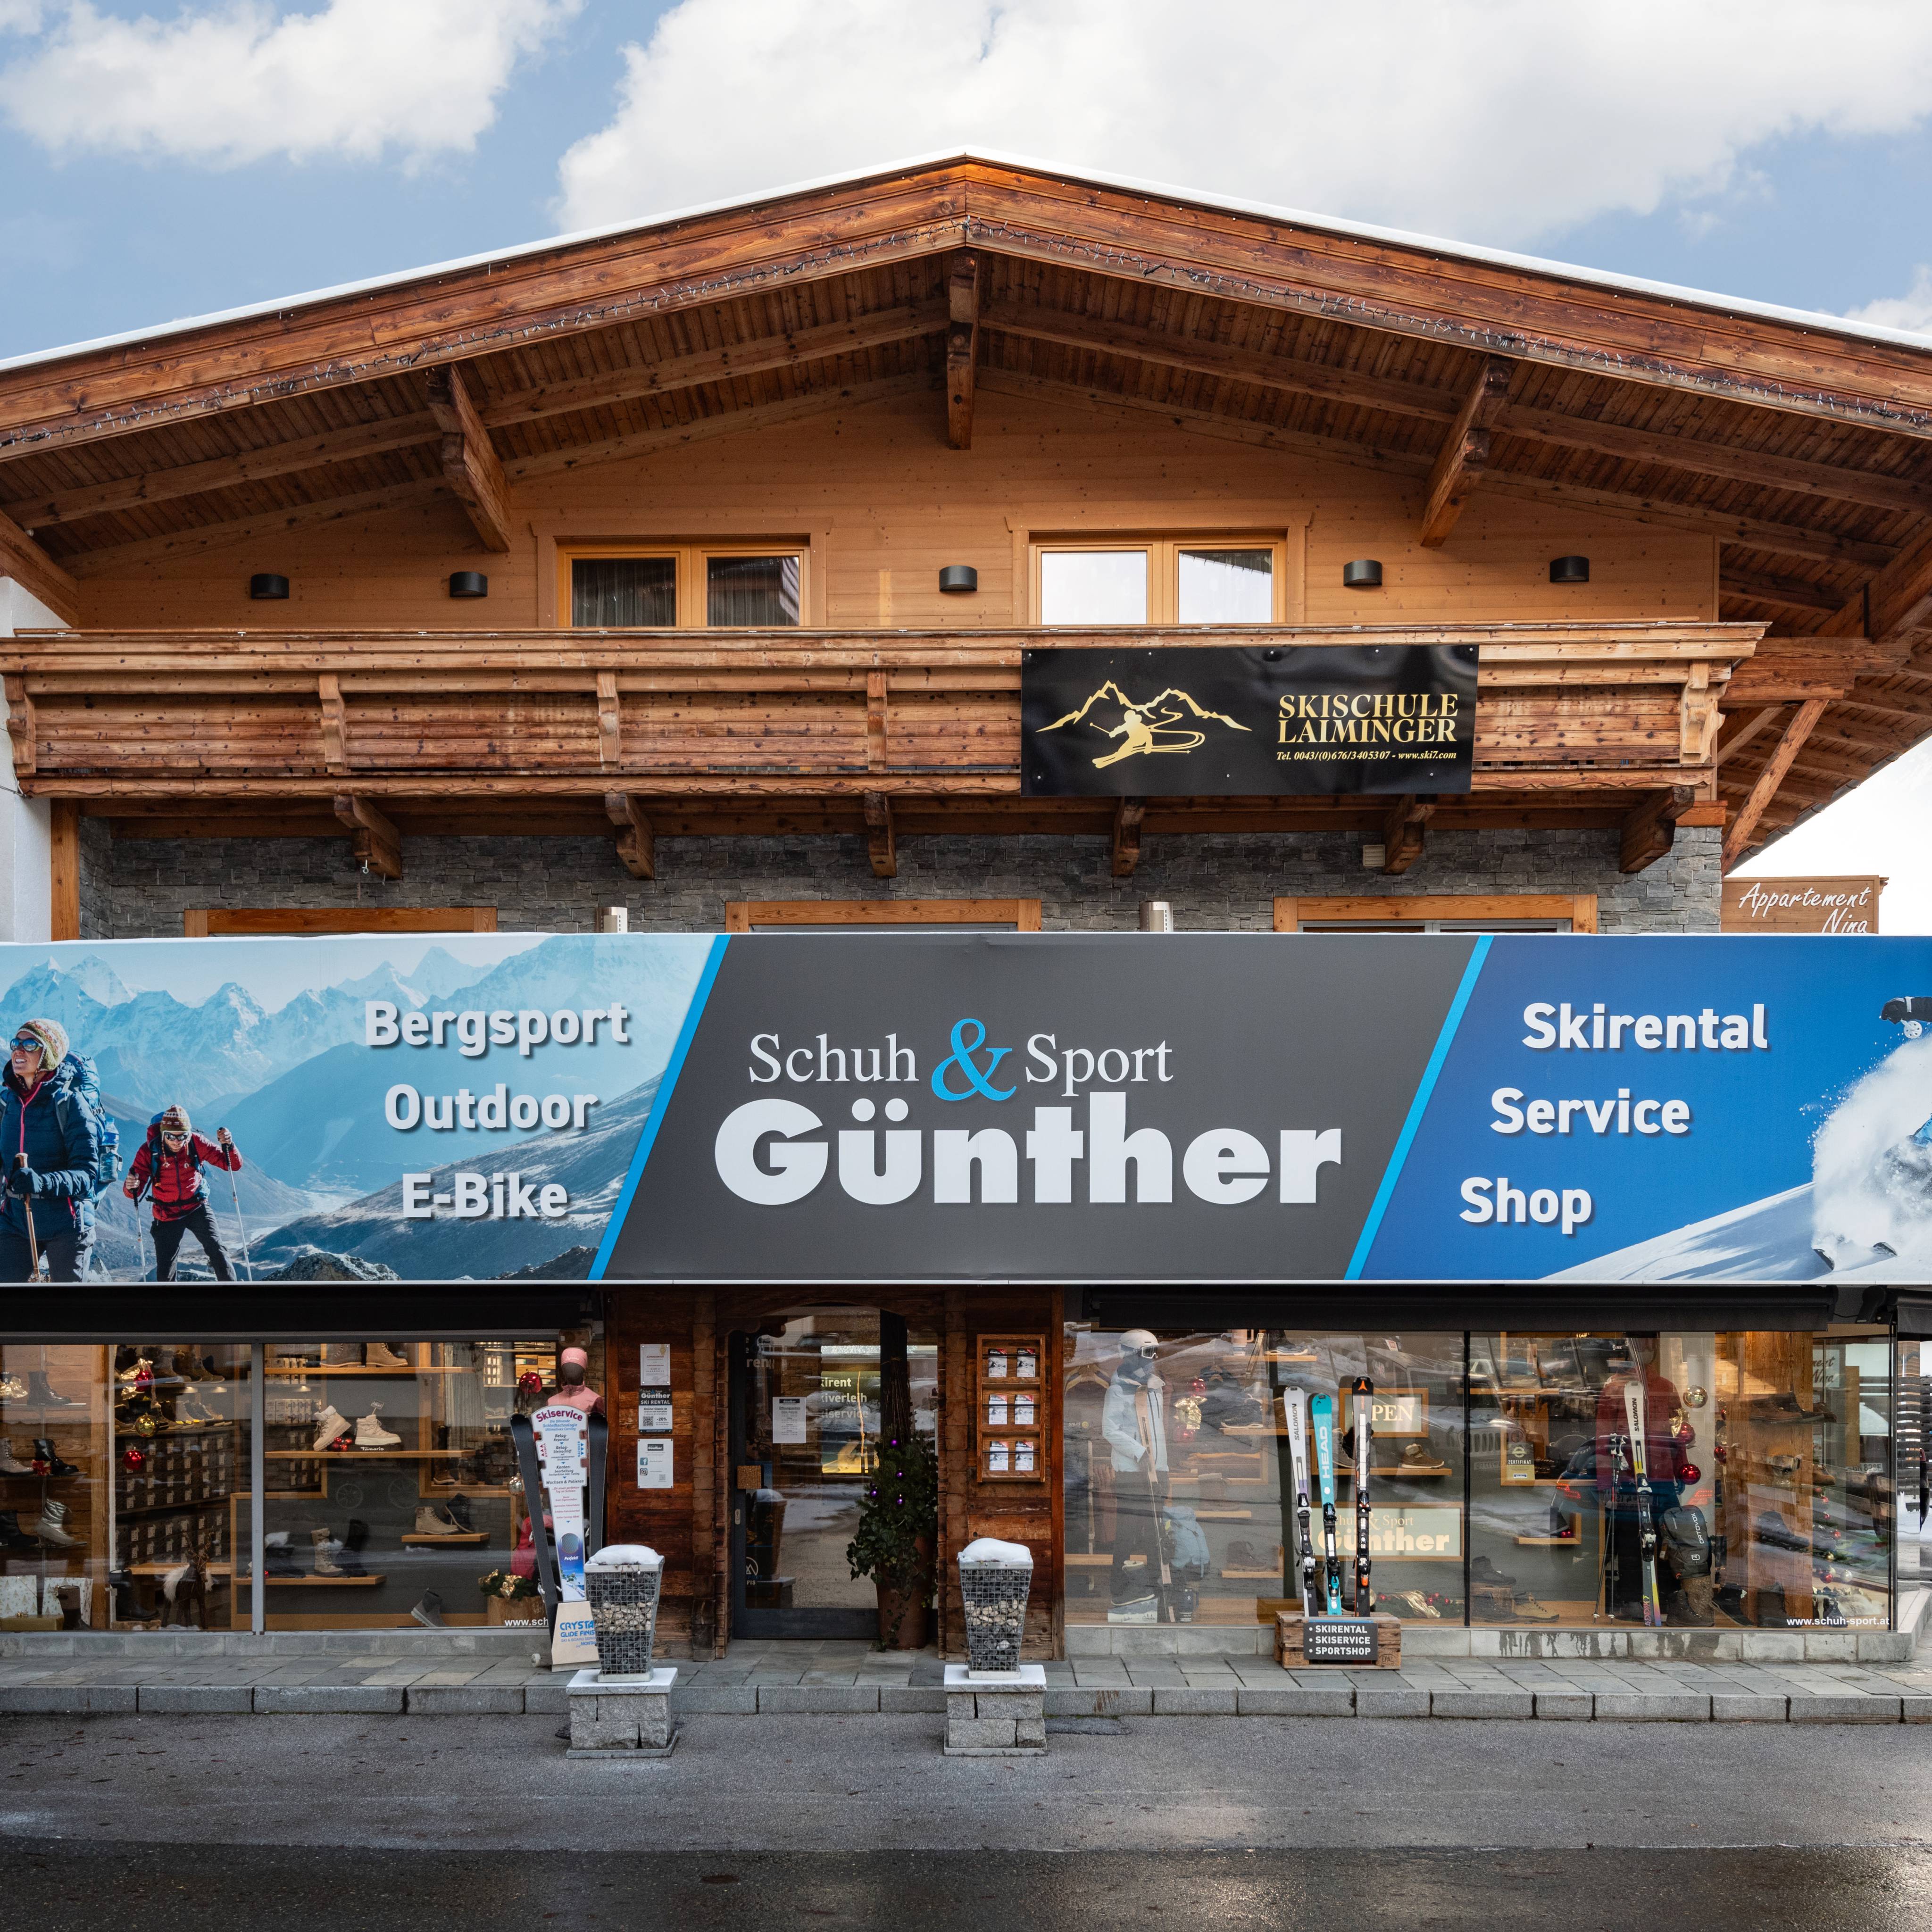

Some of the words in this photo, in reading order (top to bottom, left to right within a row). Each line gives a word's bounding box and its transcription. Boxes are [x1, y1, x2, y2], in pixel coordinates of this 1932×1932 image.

[1279, 694, 1458, 718] SKISCHULE
[1277, 719, 1457, 743] LAIMINGER
[1276, 751, 1291, 760] Tel.
[1398, 750, 1457, 760] www.ski7.com
[1738, 882, 1871, 917] Appartement
[1822, 908, 1867, 933] Nina
[366, 1001, 628, 1056] Bergsport
[1522, 1003, 1767, 1049] Skirental
[749, 1033, 919, 1083] Schuh
[931, 1018, 1017, 1101] &
[1025, 1033, 1174, 1097] Sport
[385, 1083, 598, 1129] Outdoor
[1490, 1088, 1690, 1133] Service
[715, 1091, 1341, 1206] Günther
[403, 1173, 567, 1217] E-Bike
[1459, 1177, 1591, 1234] Shop
[821, 1393, 867, 1403] iverleh
[536, 1409, 583, 1422] Skiservice
[1291, 1403, 1300, 1441] SALOMON
[1632, 1398, 1640, 1432] SALOMON
[1319, 1426, 1330, 1478] HEAD
[1382, 1515, 1414, 1527] Sport
[1690, 1513, 1704, 1544] ORTOVOX
[1317, 1527, 1449, 1551] Günther
[1315, 1625, 1367, 1633] SKIRENTAL
[1786, 1616, 1890, 1626] www.schuh-sport.at
[1315, 1636, 1370, 1644] SKISERVICE
[1315, 1647, 1371, 1656] SPORTSHOP
